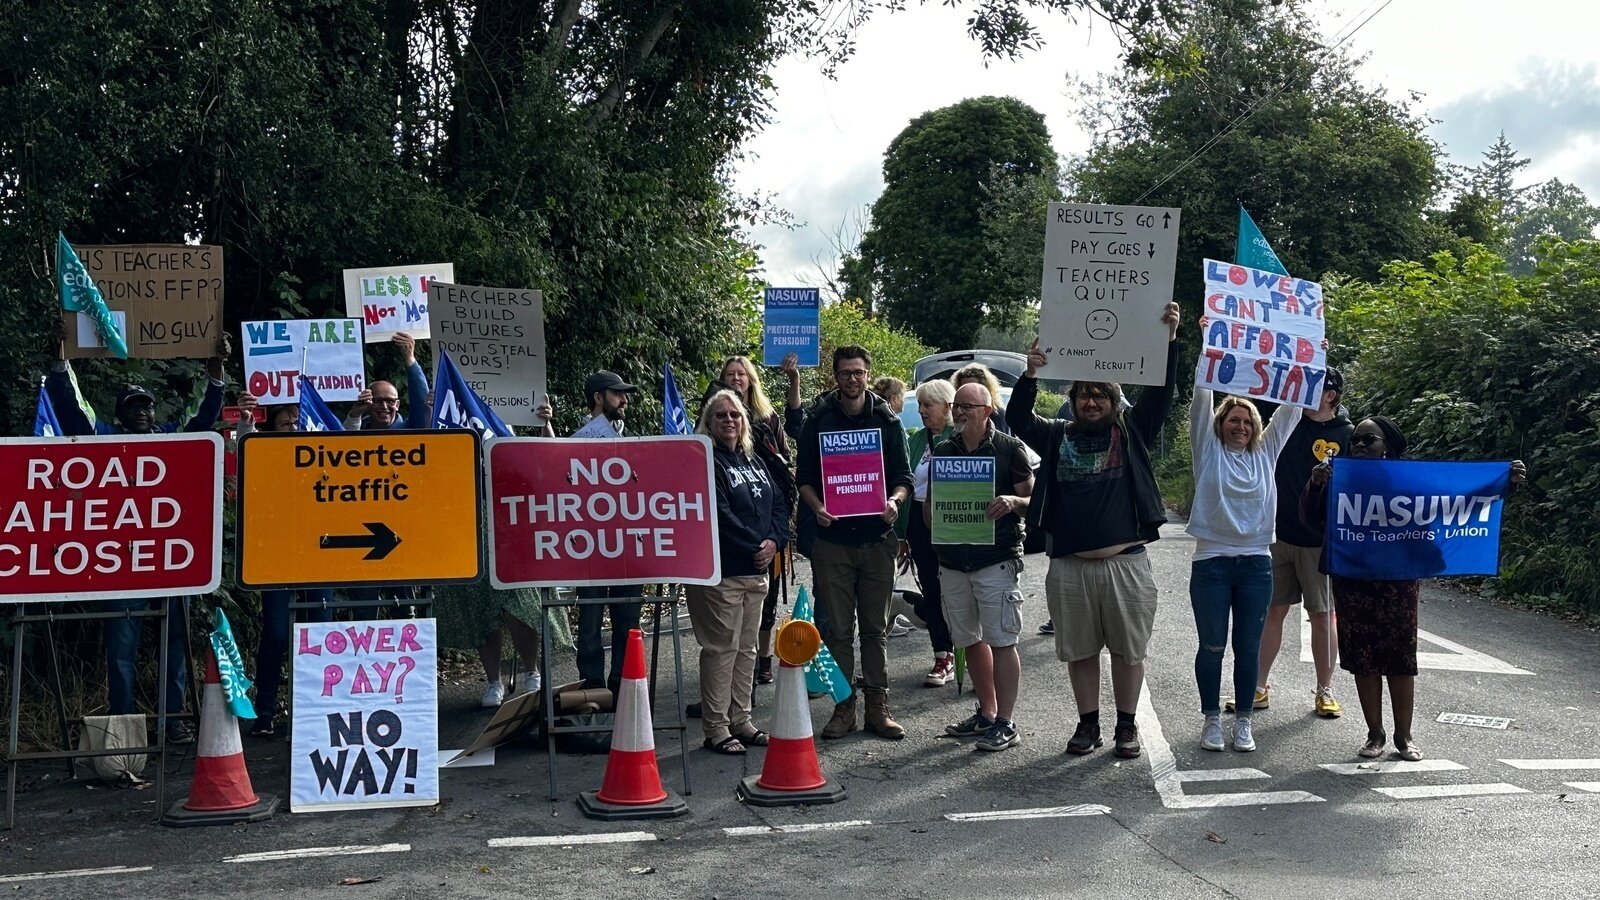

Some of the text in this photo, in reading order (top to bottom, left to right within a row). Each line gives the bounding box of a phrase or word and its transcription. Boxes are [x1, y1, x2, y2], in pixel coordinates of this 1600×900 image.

[1057, 208, 1154, 228] RESULTS GO
[1071, 240, 1141, 256] PAY GOES
[112, 249, 212, 272] TEACHER'S
[1056, 267, 1150, 286] TEACHERS
[1207, 261, 1316, 300] LOWER
[432, 285, 532, 306] TEACHERS
[767, 289, 816, 301] NASUWT
[1074, 285, 1129, 301] QUIT
[455, 306, 515, 320] BUILD
[140, 321, 167, 341] NO
[246, 320, 357, 344] WE ARE
[440, 321, 524, 337] FUTURES
[767, 325, 817, 334] PROTECT OUR
[487, 343, 537, 357] STEAL
[773, 336, 810, 346] PENSION!!
[1208, 320, 1315, 364] AFFORD
[460, 355, 510, 369] OURS!
[1059, 348, 1096, 356] CANNOT
[1205, 348, 1326, 406] TO STAY
[823, 431, 878, 448] NASUWT
[295, 443, 426, 468] Diverted
[27, 455, 167, 490] ROAD
[570, 457, 632, 487] NO
[935, 460, 992, 473] NASUWT
[827, 472, 880, 485] HANDS OFF MY
[313, 478, 409, 503] traffic
[836, 484, 873, 495] PENSION!!
[3, 497, 182, 533] AHEAD
[500, 491, 705, 526] THROUGH
[935, 501, 973, 511] PROTECT
[1337, 492, 1501, 527] NASUWT
[943, 514, 985, 524] PENSION!!
[1337, 525, 1488, 542] The Teachers' Union
[534, 527, 677, 561] ROUTE
[0, 538, 195, 577] CLOSED
[298, 623, 424, 656] LOWER
[320, 655, 416, 704] PAY?
[326, 709, 403, 748] NO
[308, 748, 419, 797] WAY!
